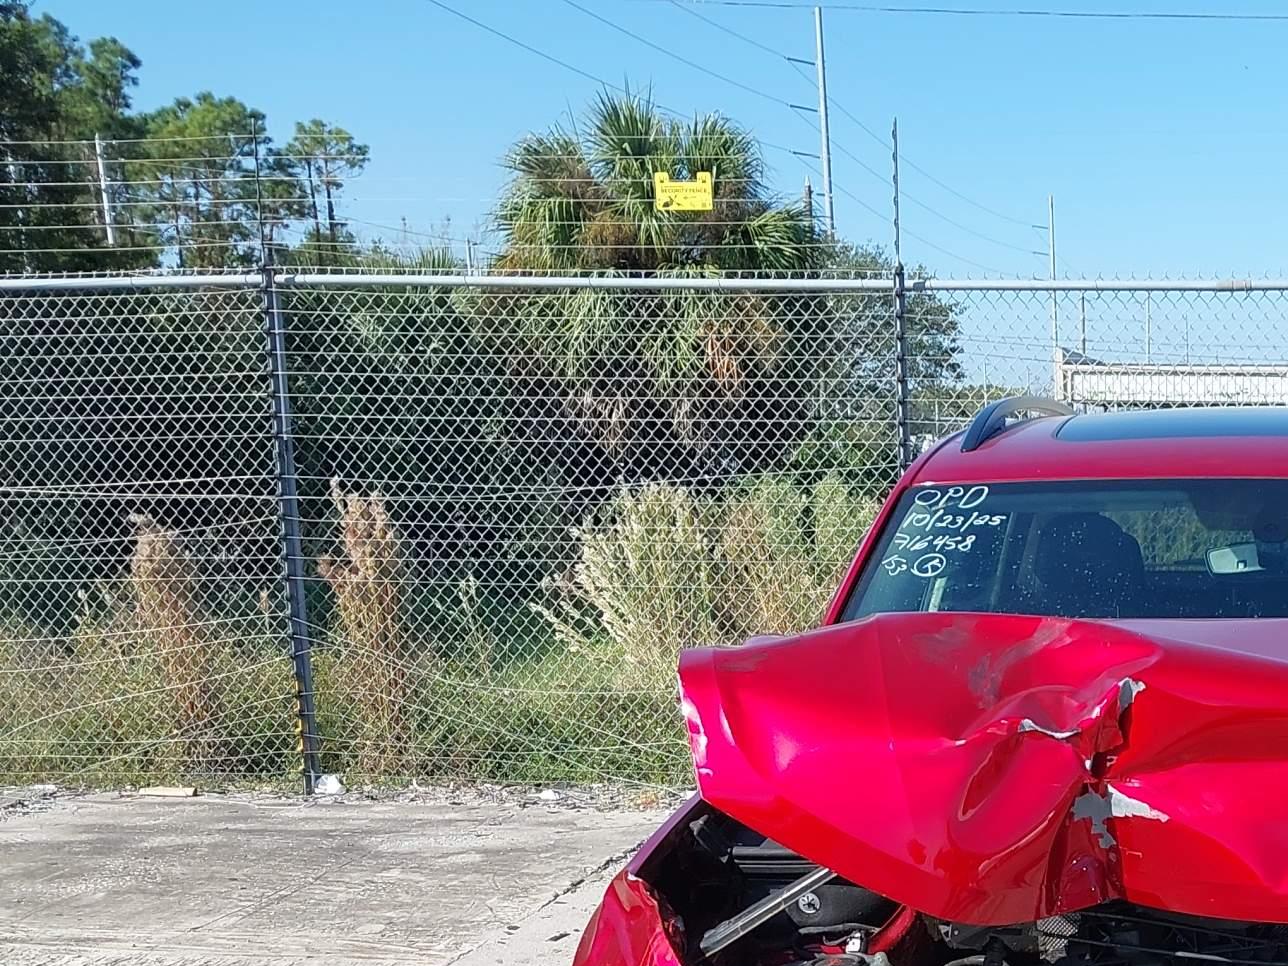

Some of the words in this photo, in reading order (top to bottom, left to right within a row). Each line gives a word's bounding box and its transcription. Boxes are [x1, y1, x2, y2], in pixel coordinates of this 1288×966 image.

[914, 486, 989, 509] OPD
[903, 509, 1007, 532] 10/23/25
[894, 532, 977, 552] 716458
